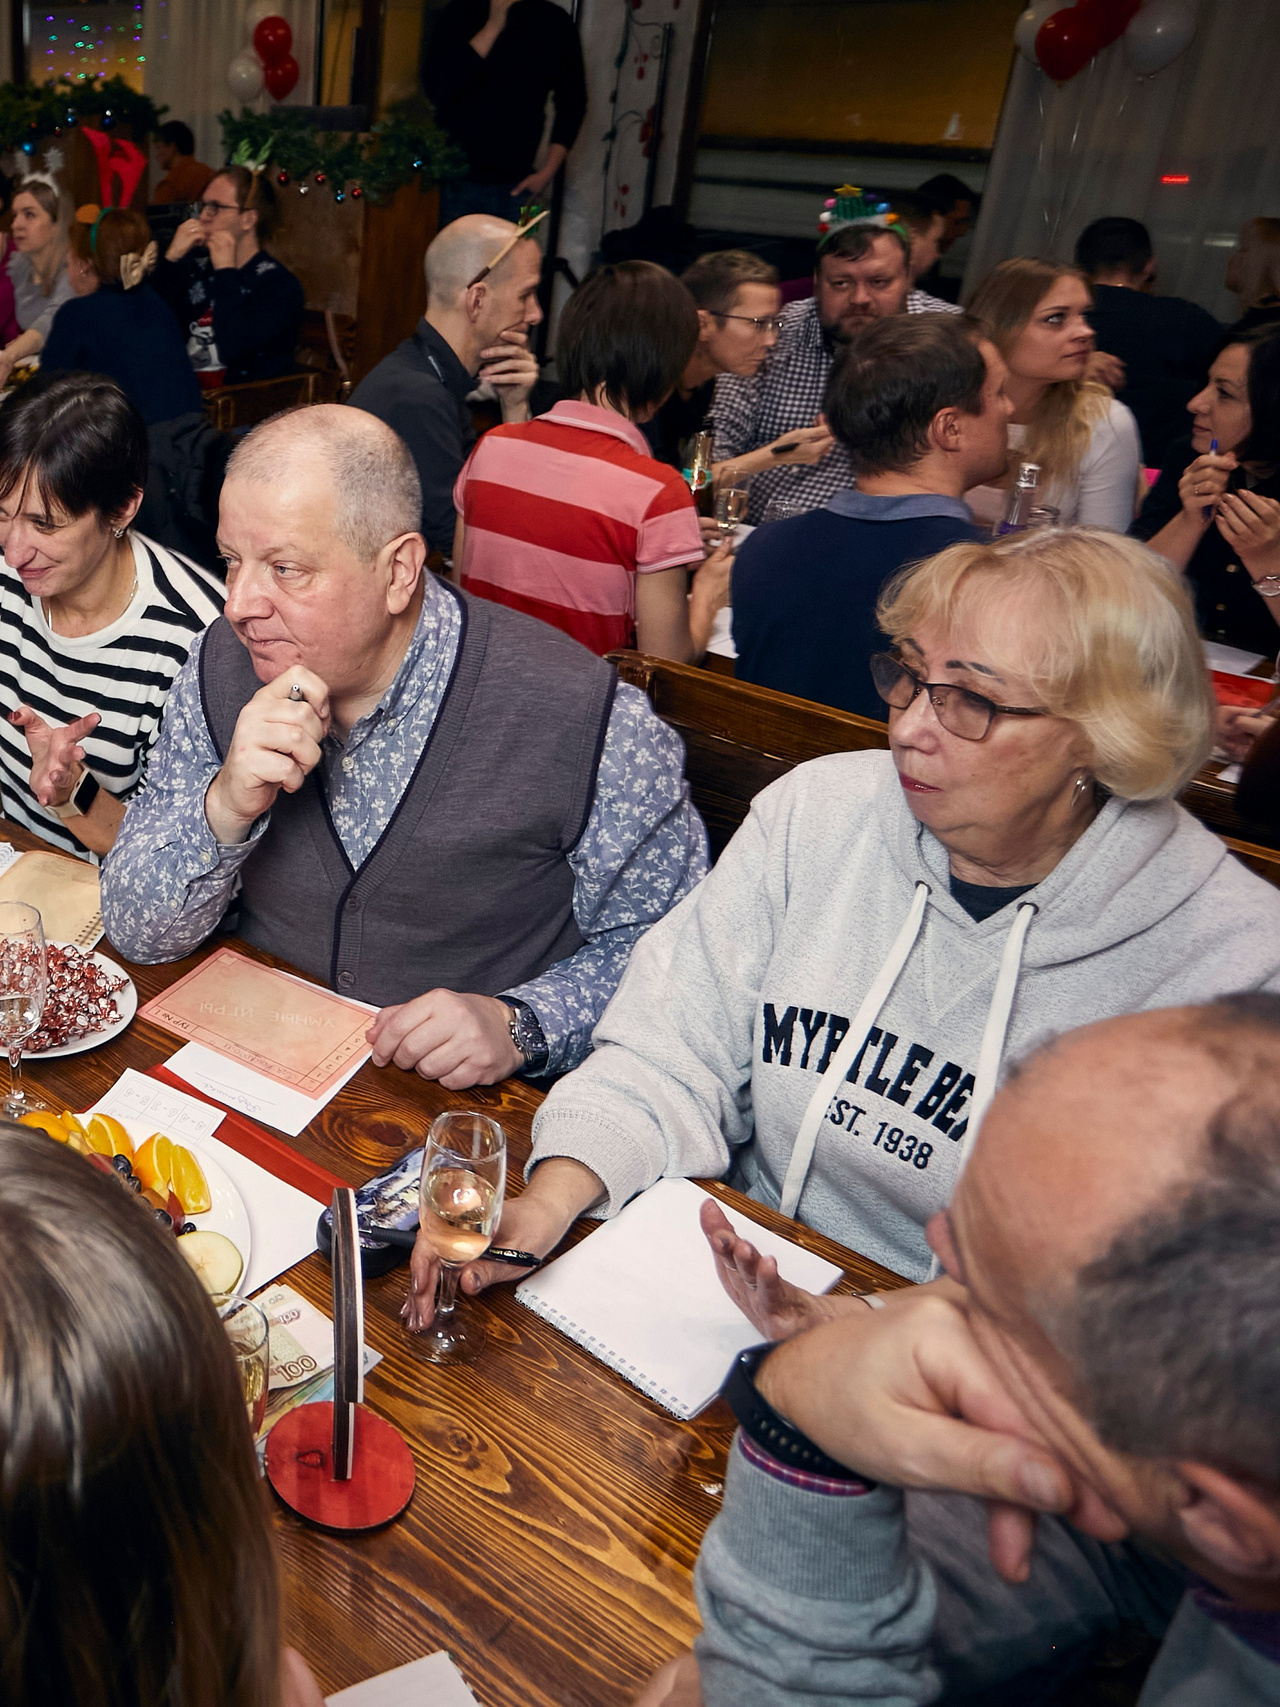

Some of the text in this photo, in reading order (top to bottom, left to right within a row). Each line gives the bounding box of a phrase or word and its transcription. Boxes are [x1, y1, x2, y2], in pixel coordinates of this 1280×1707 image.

[172, 1020, 190, 1030] ТУР
[200, 1001, 335, 1029] УМНЫЕ ИГРЫ
[824, 1096, 933, 1170] ST. 1938
[278, 1309, 302, 1326] 100
[277, 1354, 317, 1382] 100
